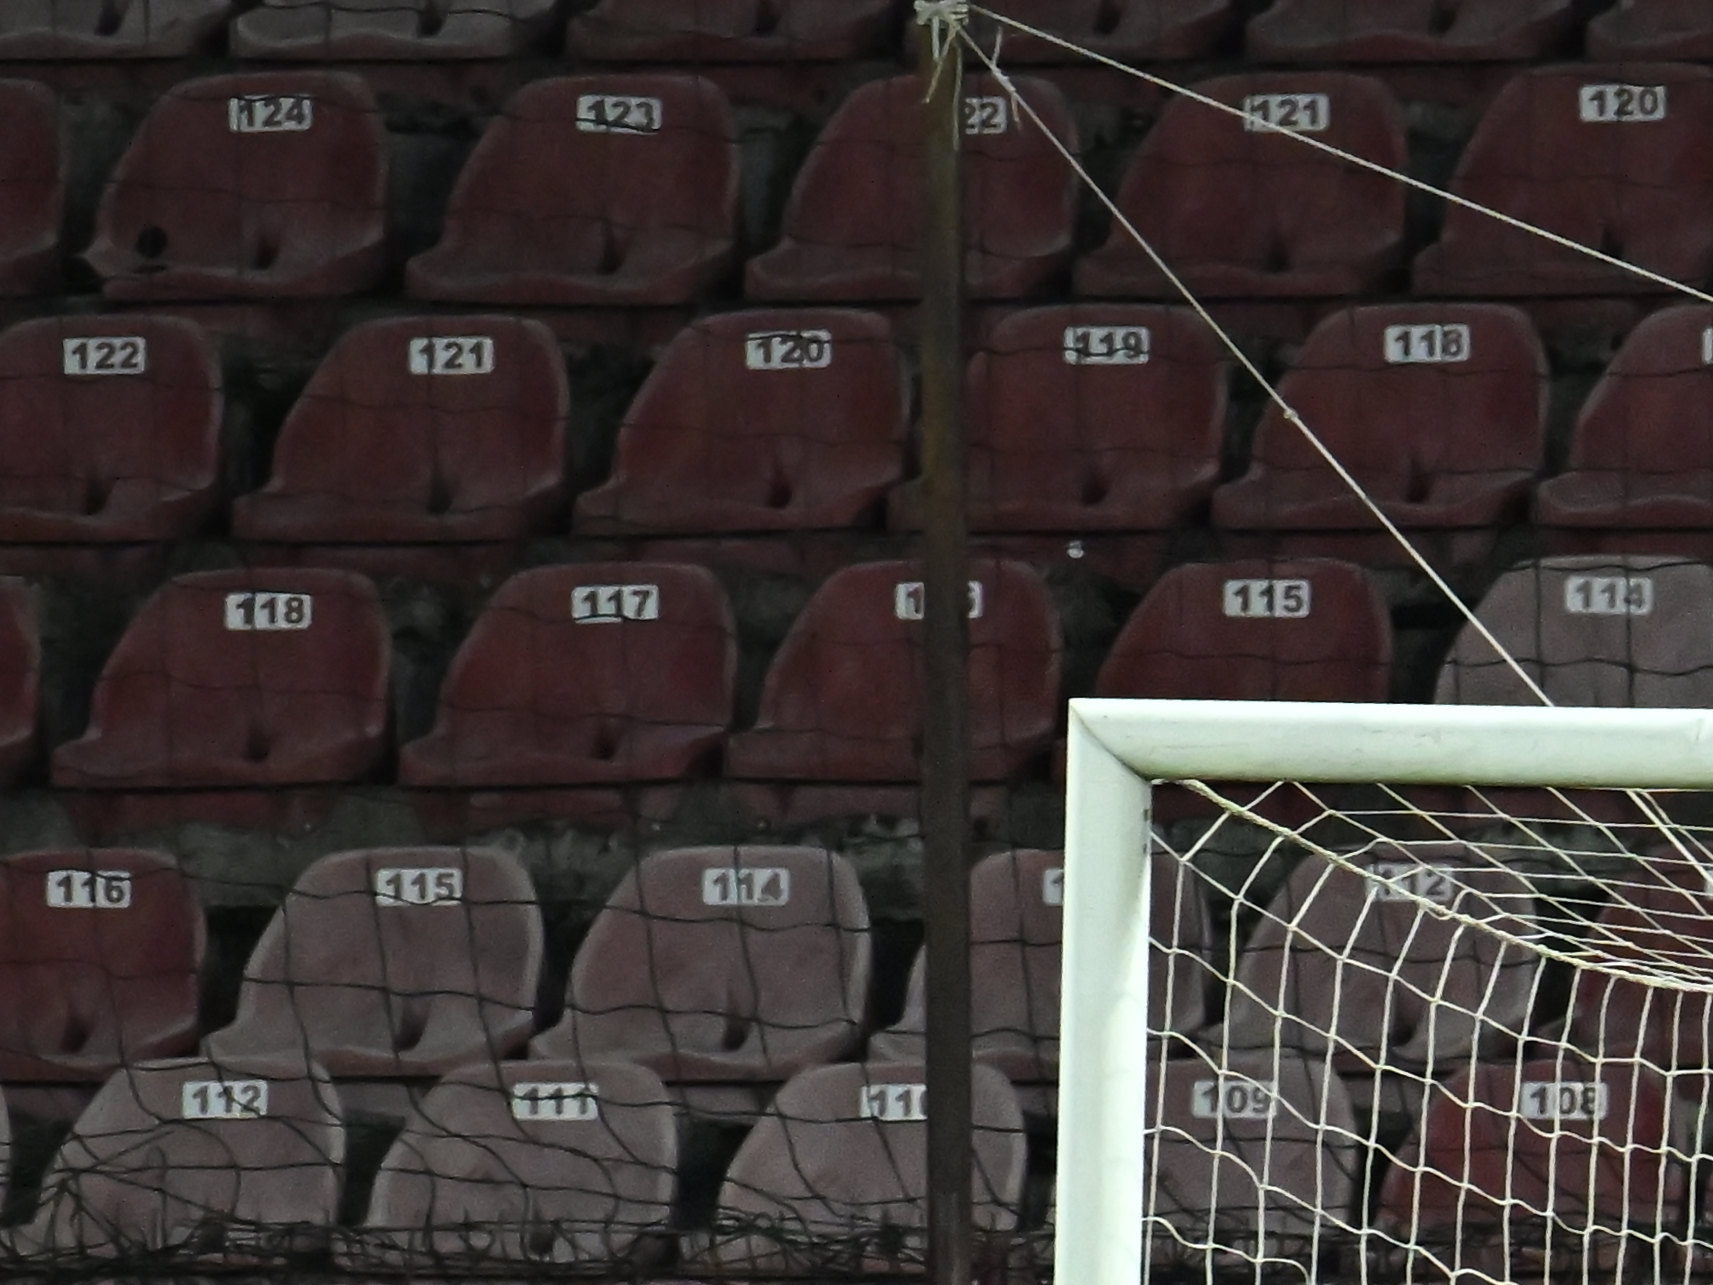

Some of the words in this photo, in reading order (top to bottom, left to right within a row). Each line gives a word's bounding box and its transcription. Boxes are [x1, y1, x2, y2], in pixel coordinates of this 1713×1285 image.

[239, 99, 307, 127] 124
[1250, 99, 1318, 126] 121
[1588, 88, 1657, 118] 120
[71, 341, 138, 370] 122
[419, 341, 485, 370] 121
[757, 334, 824, 364] 120
[1074, 330, 1141, 359] 119
[1393, 329, 1462, 359] 118
[234, 597, 303, 626] 118
[582, 589, 650, 619] 117
[1233, 583, 1303, 613] 115
[56, 873, 124, 904] 116
[385, 872, 454, 903] 115
[713, 872, 781, 903] 114
[191, 1084, 261, 1115] 112
[522, 1087, 591, 1117] 111
[1202, 1085, 1269, 1115] 109
[1530, 1086, 1600, 1115] 108
